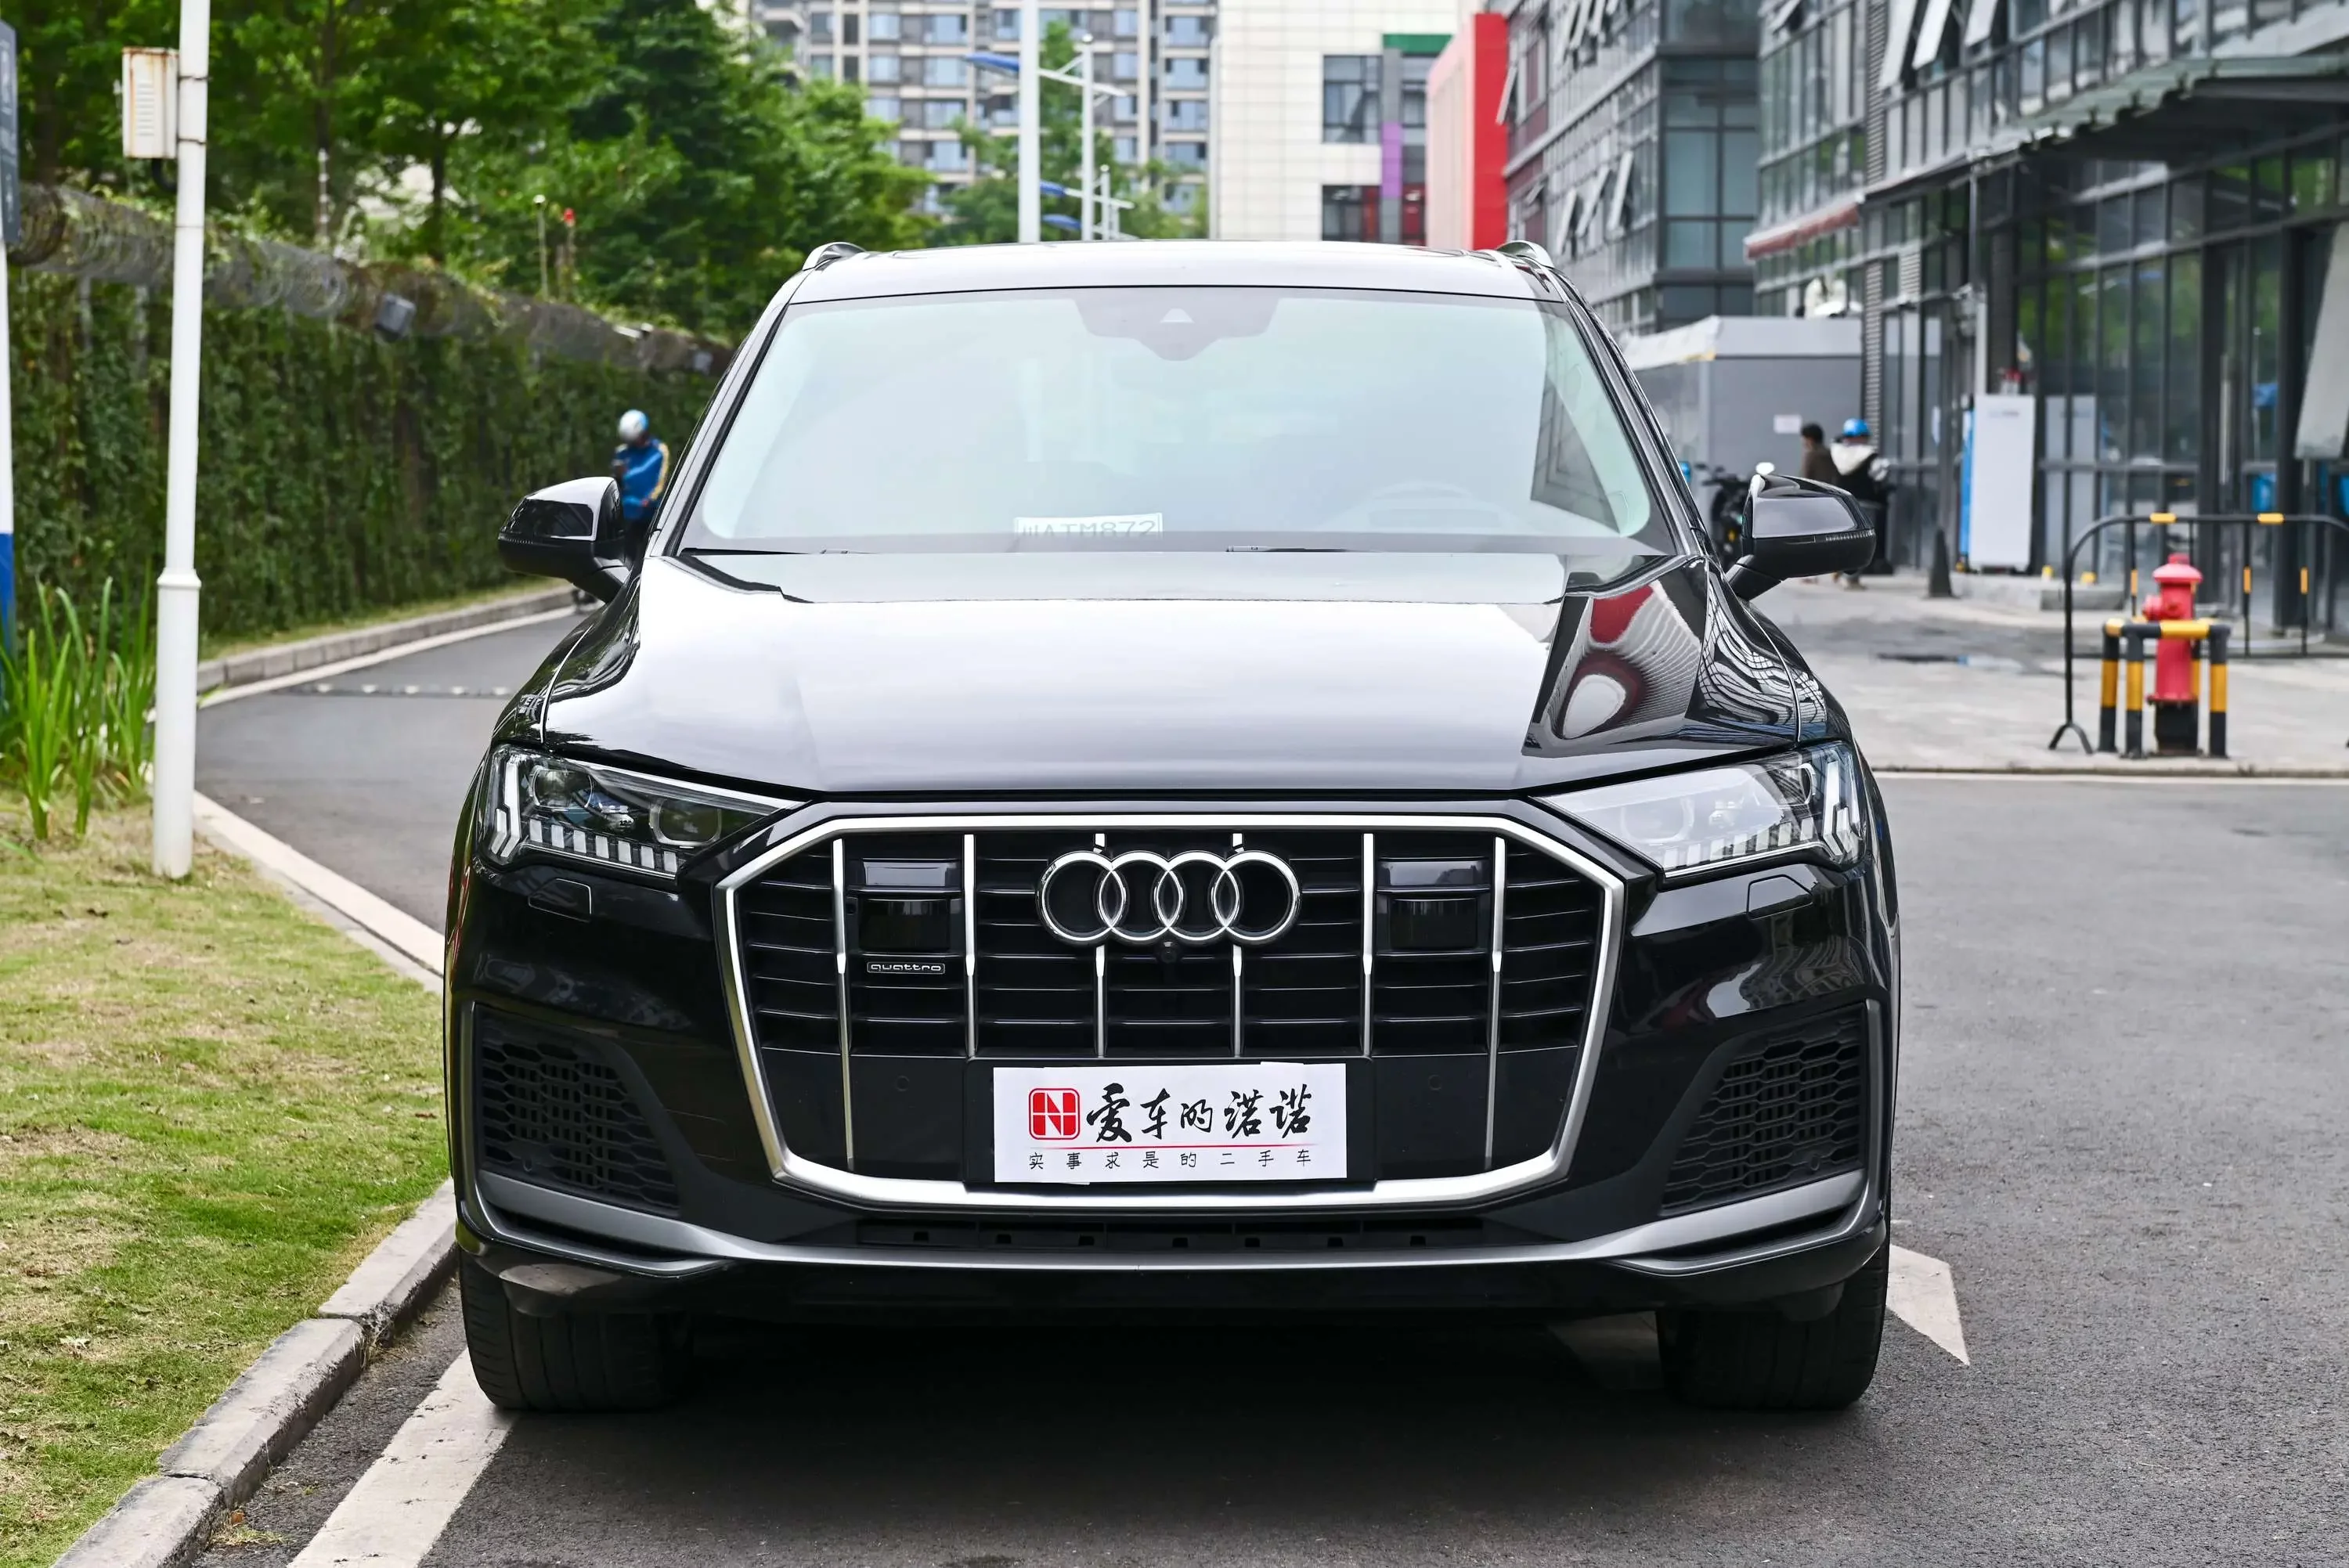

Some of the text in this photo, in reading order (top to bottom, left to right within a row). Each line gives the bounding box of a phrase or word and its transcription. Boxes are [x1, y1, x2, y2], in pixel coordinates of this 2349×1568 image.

[1086, 1083, 1312, 1143] 爱车的诺诺
[1028, 1148, 1312, 1170] 实事求是的二手车
